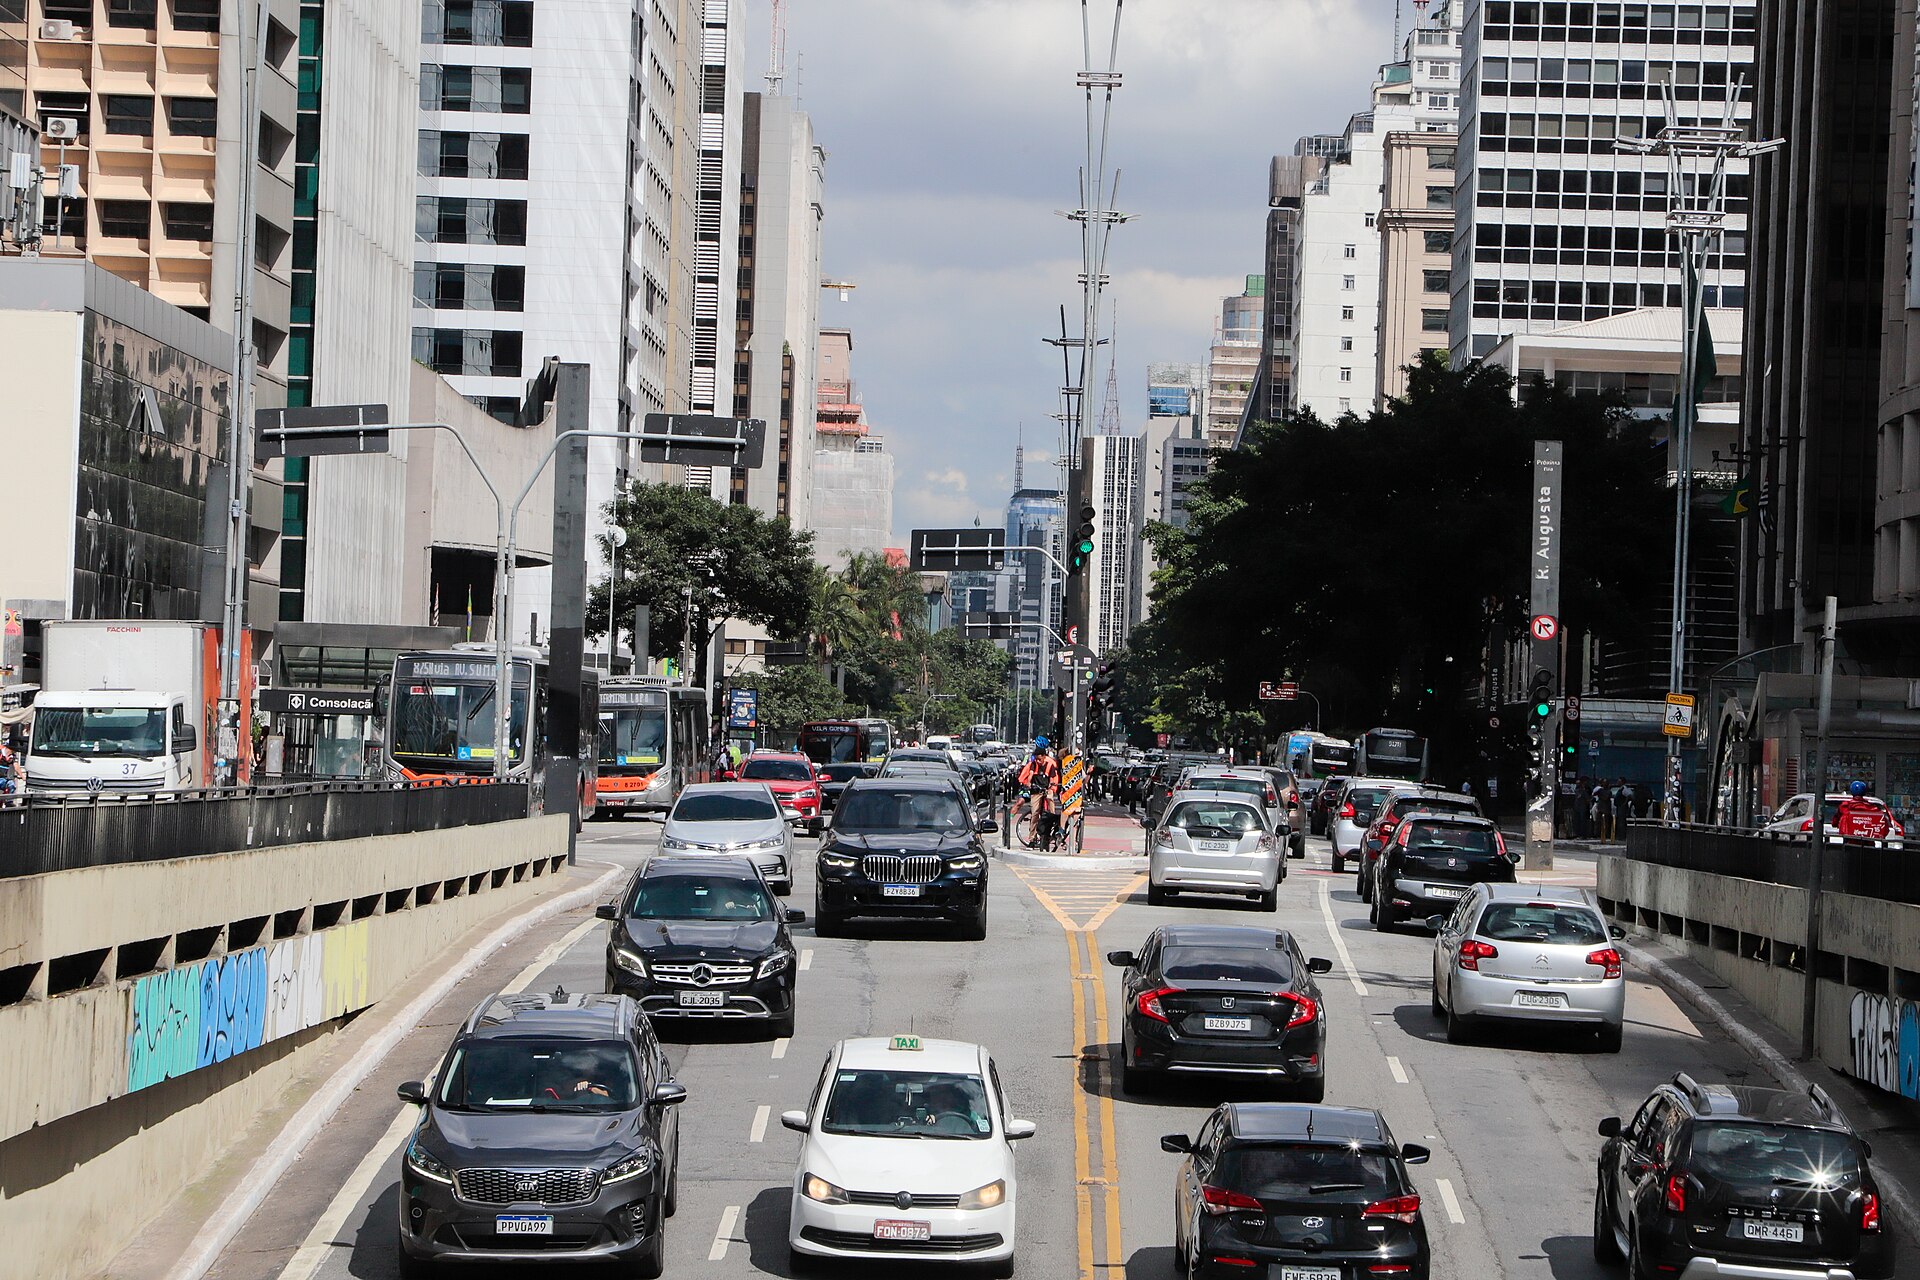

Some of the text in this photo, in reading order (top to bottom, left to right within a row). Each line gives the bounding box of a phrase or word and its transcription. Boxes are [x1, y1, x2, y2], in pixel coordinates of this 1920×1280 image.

[1536, 486, 1554, 560] Augusta
[1489, 668, 1499, 703] Augusta
[309, 697, 374, 710] Consolaçã
[122, 763, 138, 775] 37
[894, 1037, 919, 1049] TAXI
[517, 1182, 535, 1191] KIA
